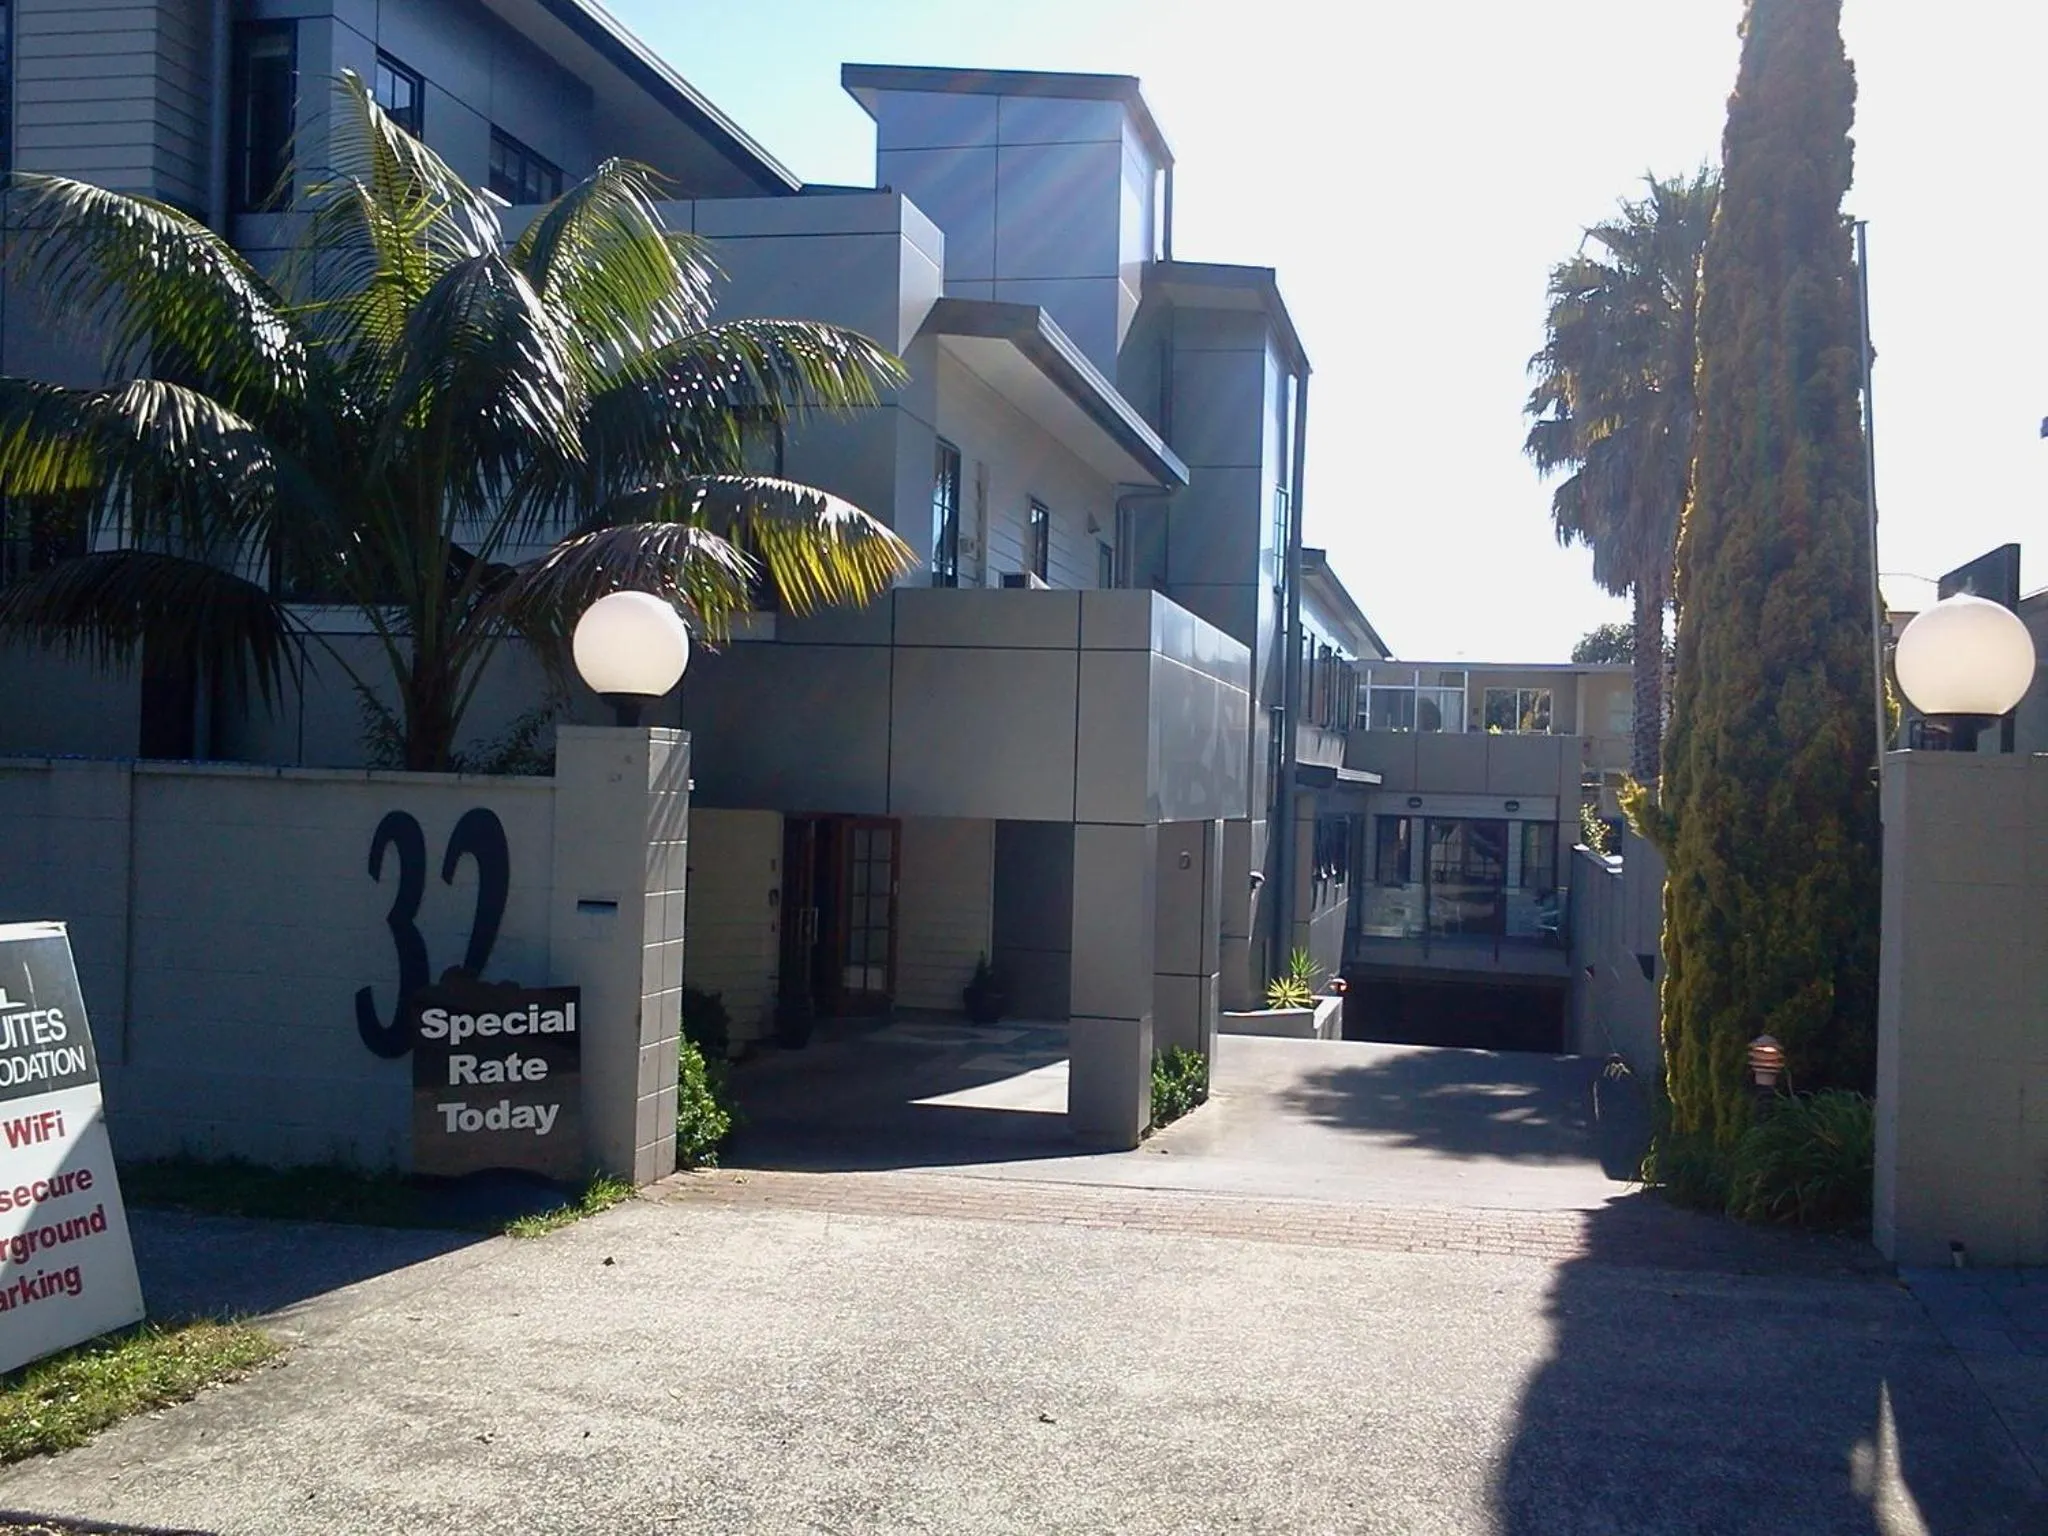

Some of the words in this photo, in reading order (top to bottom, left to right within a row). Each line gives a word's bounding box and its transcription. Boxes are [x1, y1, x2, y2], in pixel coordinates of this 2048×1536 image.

[355, 807, 510, 1059] 32
[420, 1002, 576, 1045] Special
[449, 1052, 548, 1085] Rate
[3, 1110, 66, 1149] WiFi
[437, 1100, 560, 1136] Today
[0, 1168, 93, 1213] secure
[0, 1204, 107, 1265] rground
